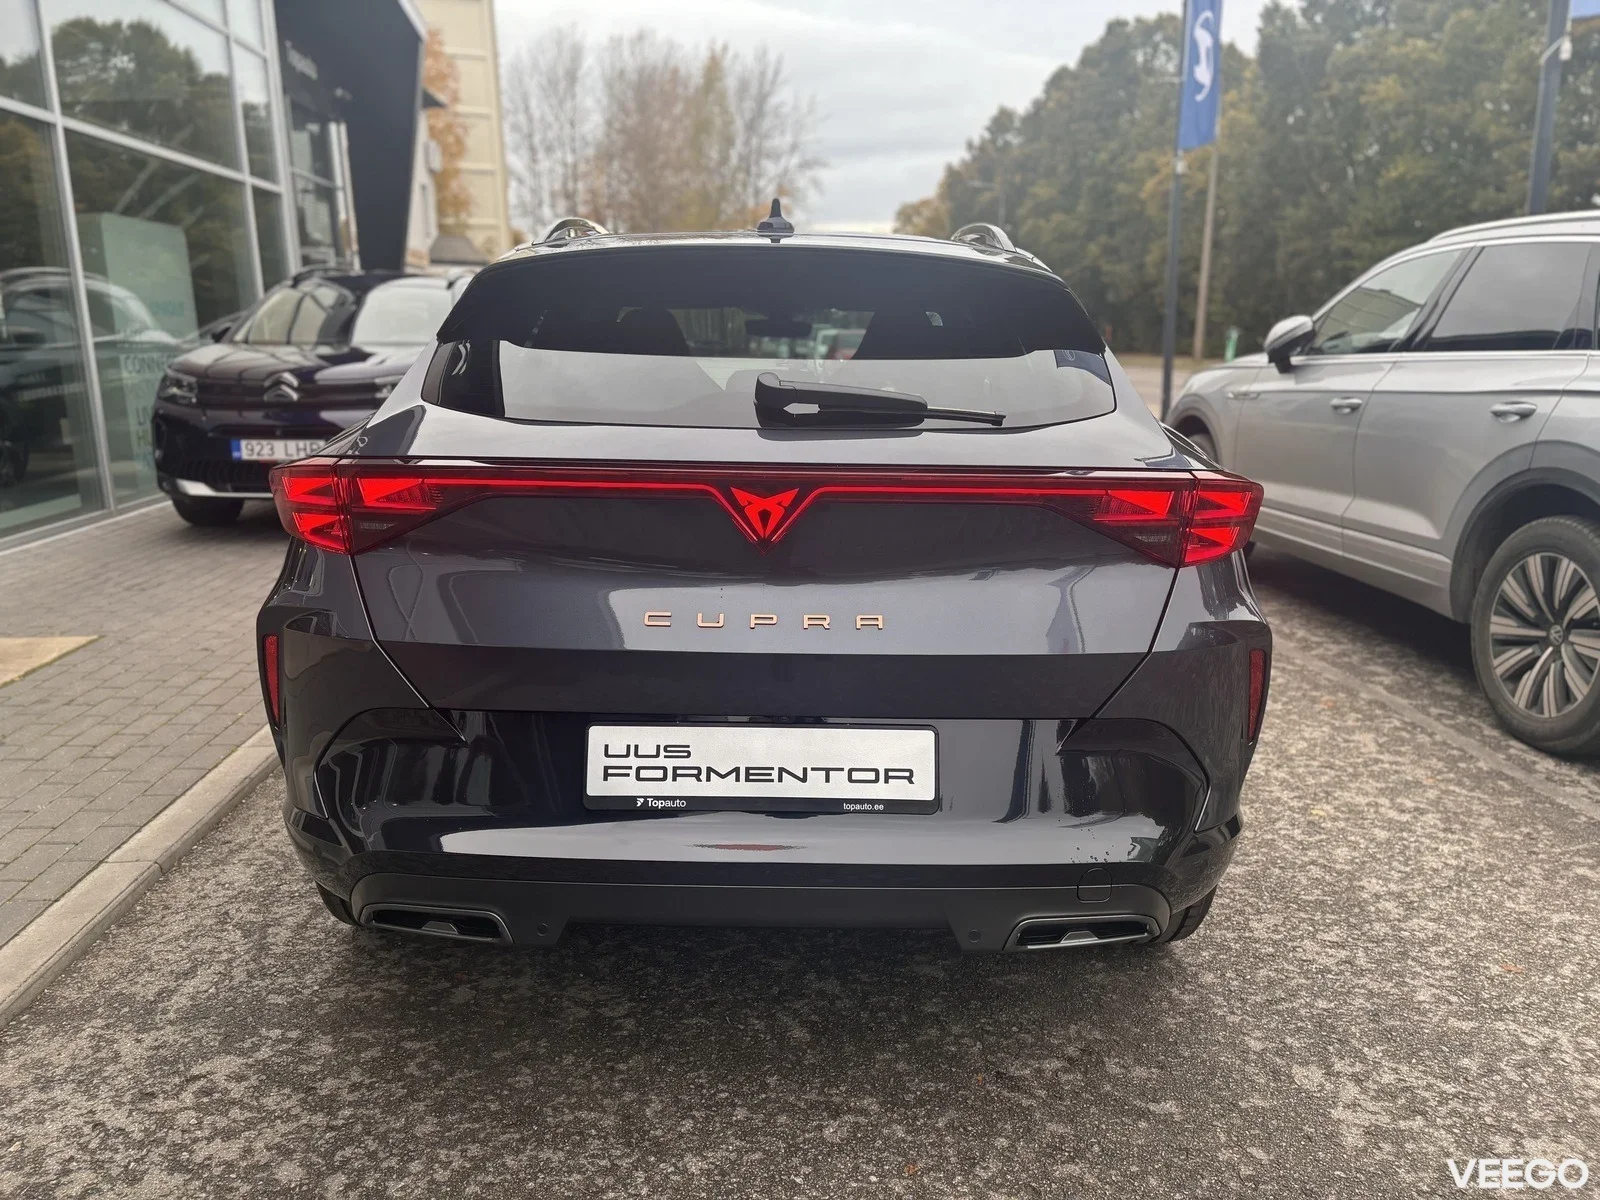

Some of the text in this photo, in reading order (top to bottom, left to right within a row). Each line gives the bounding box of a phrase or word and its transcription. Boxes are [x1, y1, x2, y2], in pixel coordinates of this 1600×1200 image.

[245, 441, 275, 457] 923
[643, 611, 885, 630] CUPRA
[603, 743, 691, 759] UUS
[602, 765, 915, 785] FORMENTOR
[646, 797, 687, 809] Topauto
[843, 802, 884, 812] topauto.ee
